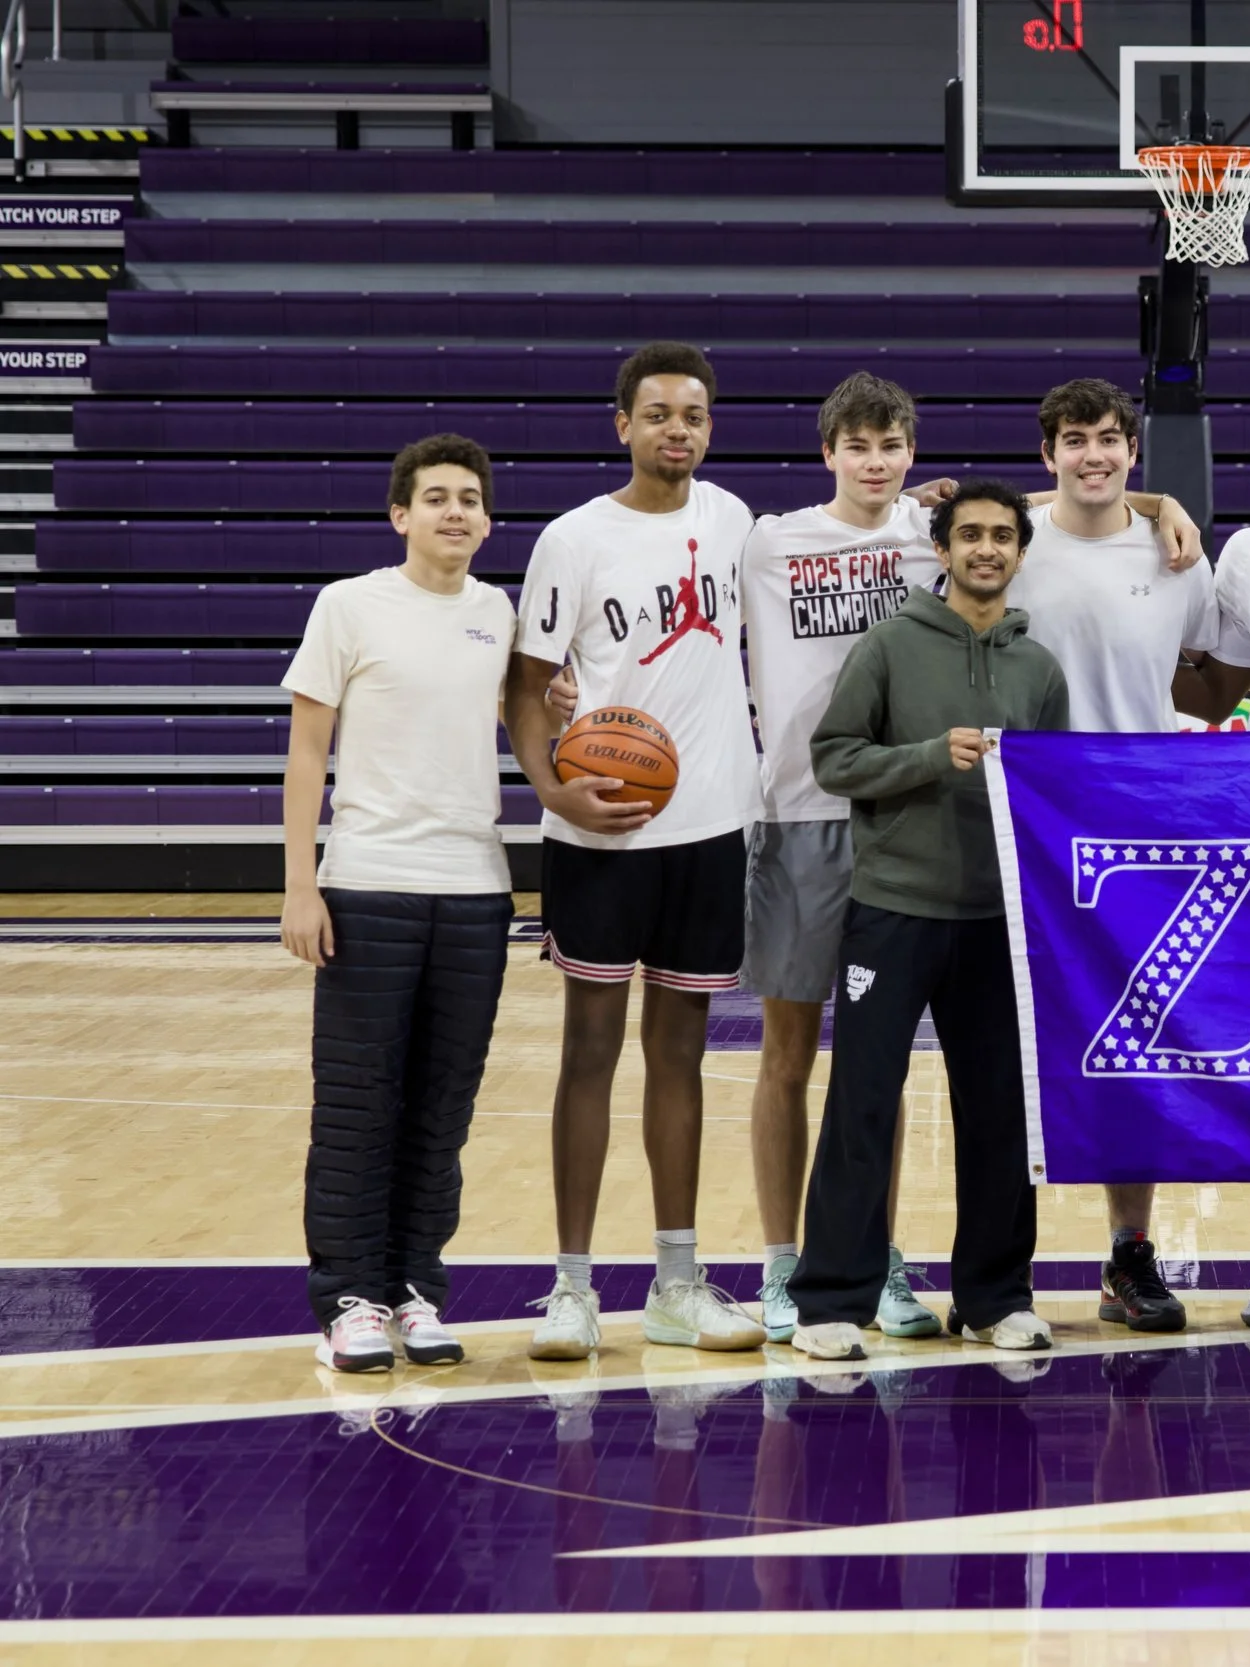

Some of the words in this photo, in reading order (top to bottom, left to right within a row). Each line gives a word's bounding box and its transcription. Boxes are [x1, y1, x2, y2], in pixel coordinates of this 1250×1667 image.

[36, 207, 79, 223] YOUR
[81, 208, 121, 224] STEP
[0, 352, 43, 368] YOUR
[45, 352, 87, 368] STEP
[859, 544, 900, 553] VOLLEYBALL
[788, 556, 842, 597] 2025
[848, 551, 904, 590] FCIAC
[591, 710, 671, 748] Wilson
[583, 743, 662, 772] EVOLUTION
